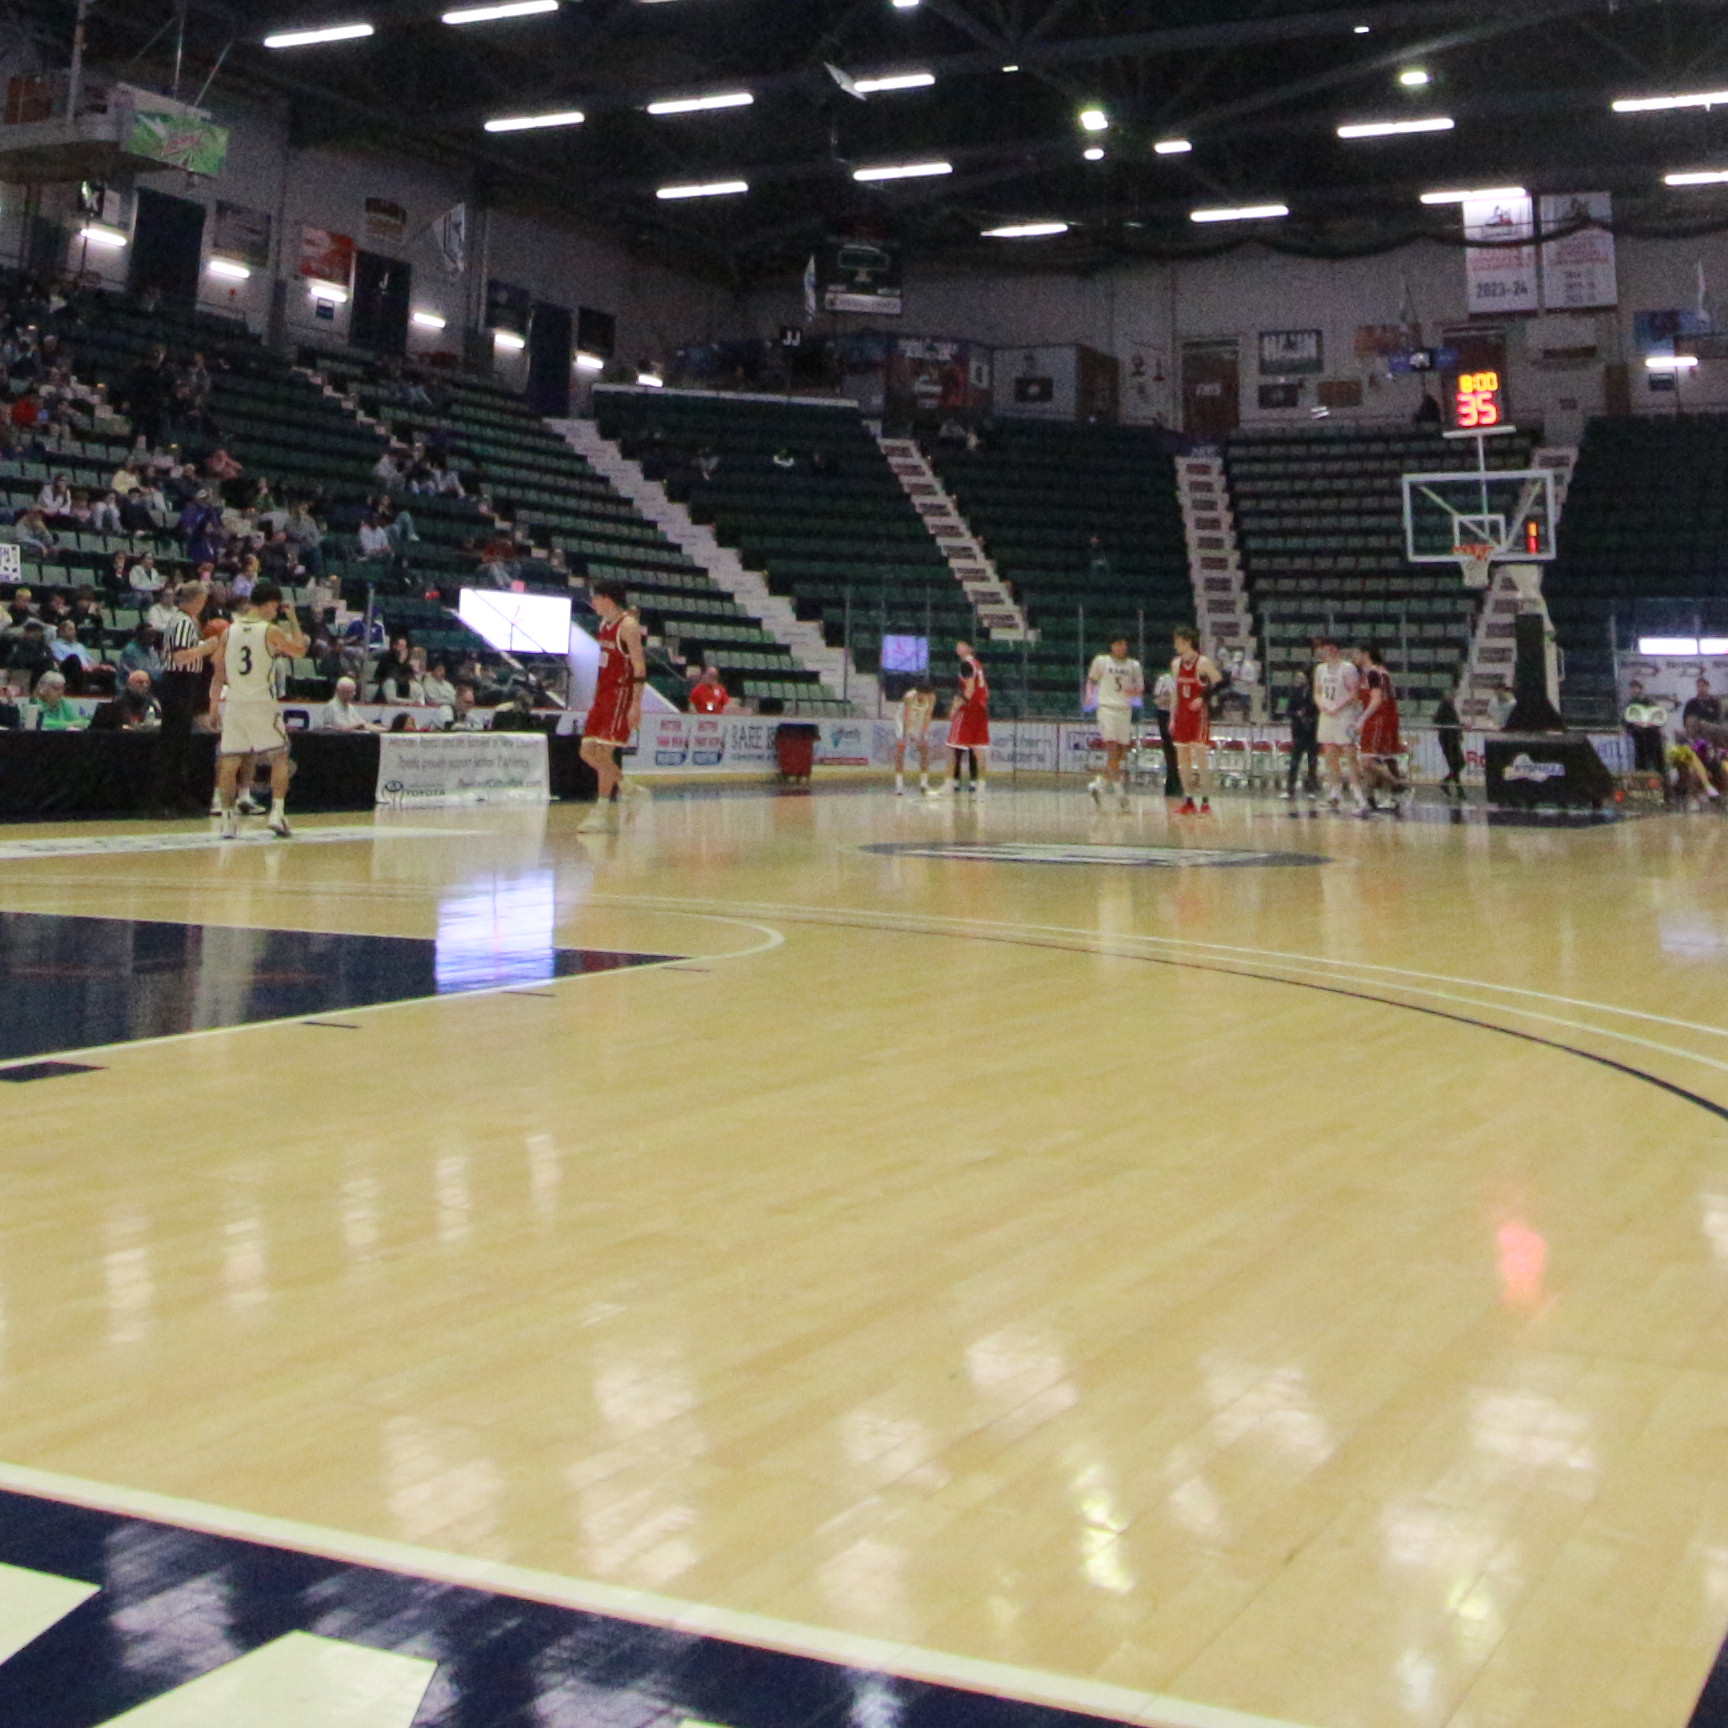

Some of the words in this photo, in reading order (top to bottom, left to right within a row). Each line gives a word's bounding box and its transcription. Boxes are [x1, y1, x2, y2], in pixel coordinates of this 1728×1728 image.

[1458, 371, 1499, 393] 8:00
[1456, 391, 1498, 427] 35
[238, 645, 253, 675] 3
